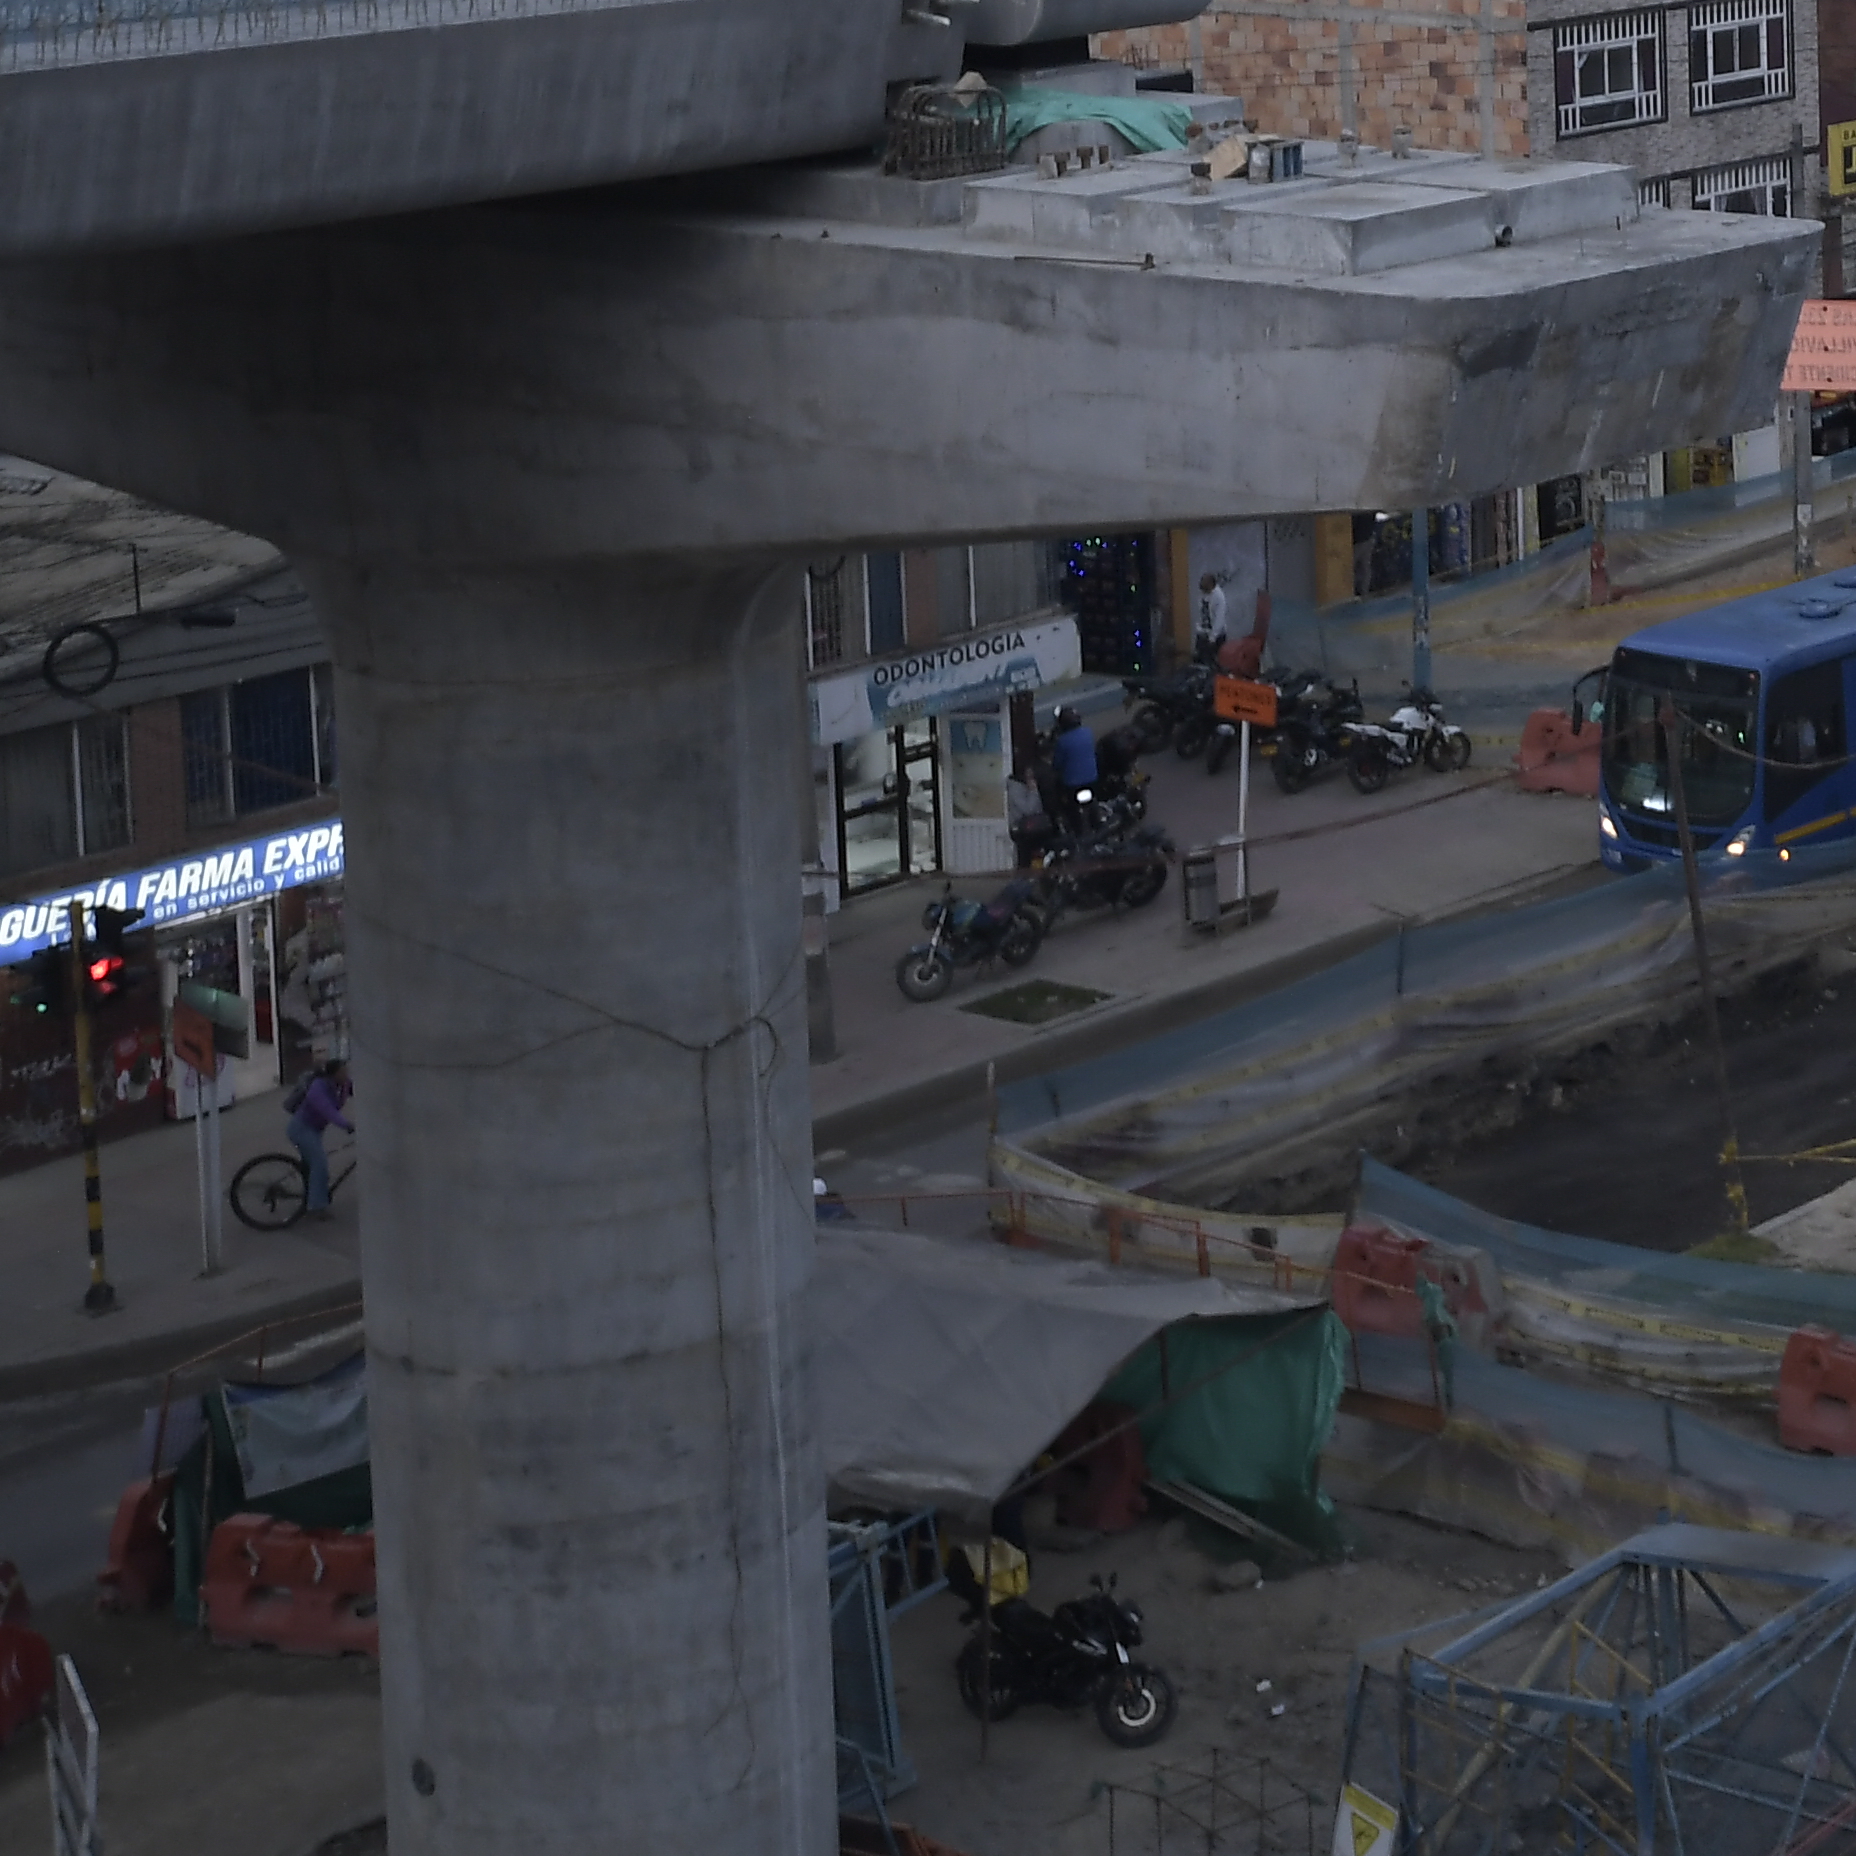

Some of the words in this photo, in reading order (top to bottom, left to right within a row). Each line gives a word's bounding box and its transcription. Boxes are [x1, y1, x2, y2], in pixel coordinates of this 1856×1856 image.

[874, 631, 1025, 685] ODONTOLOGIA
[136, 847, 254, 909] FARMA
[153, 901, 177, 919] en
[187, 878, 265, 911] servicio
[273, 872, 286, 891] y
